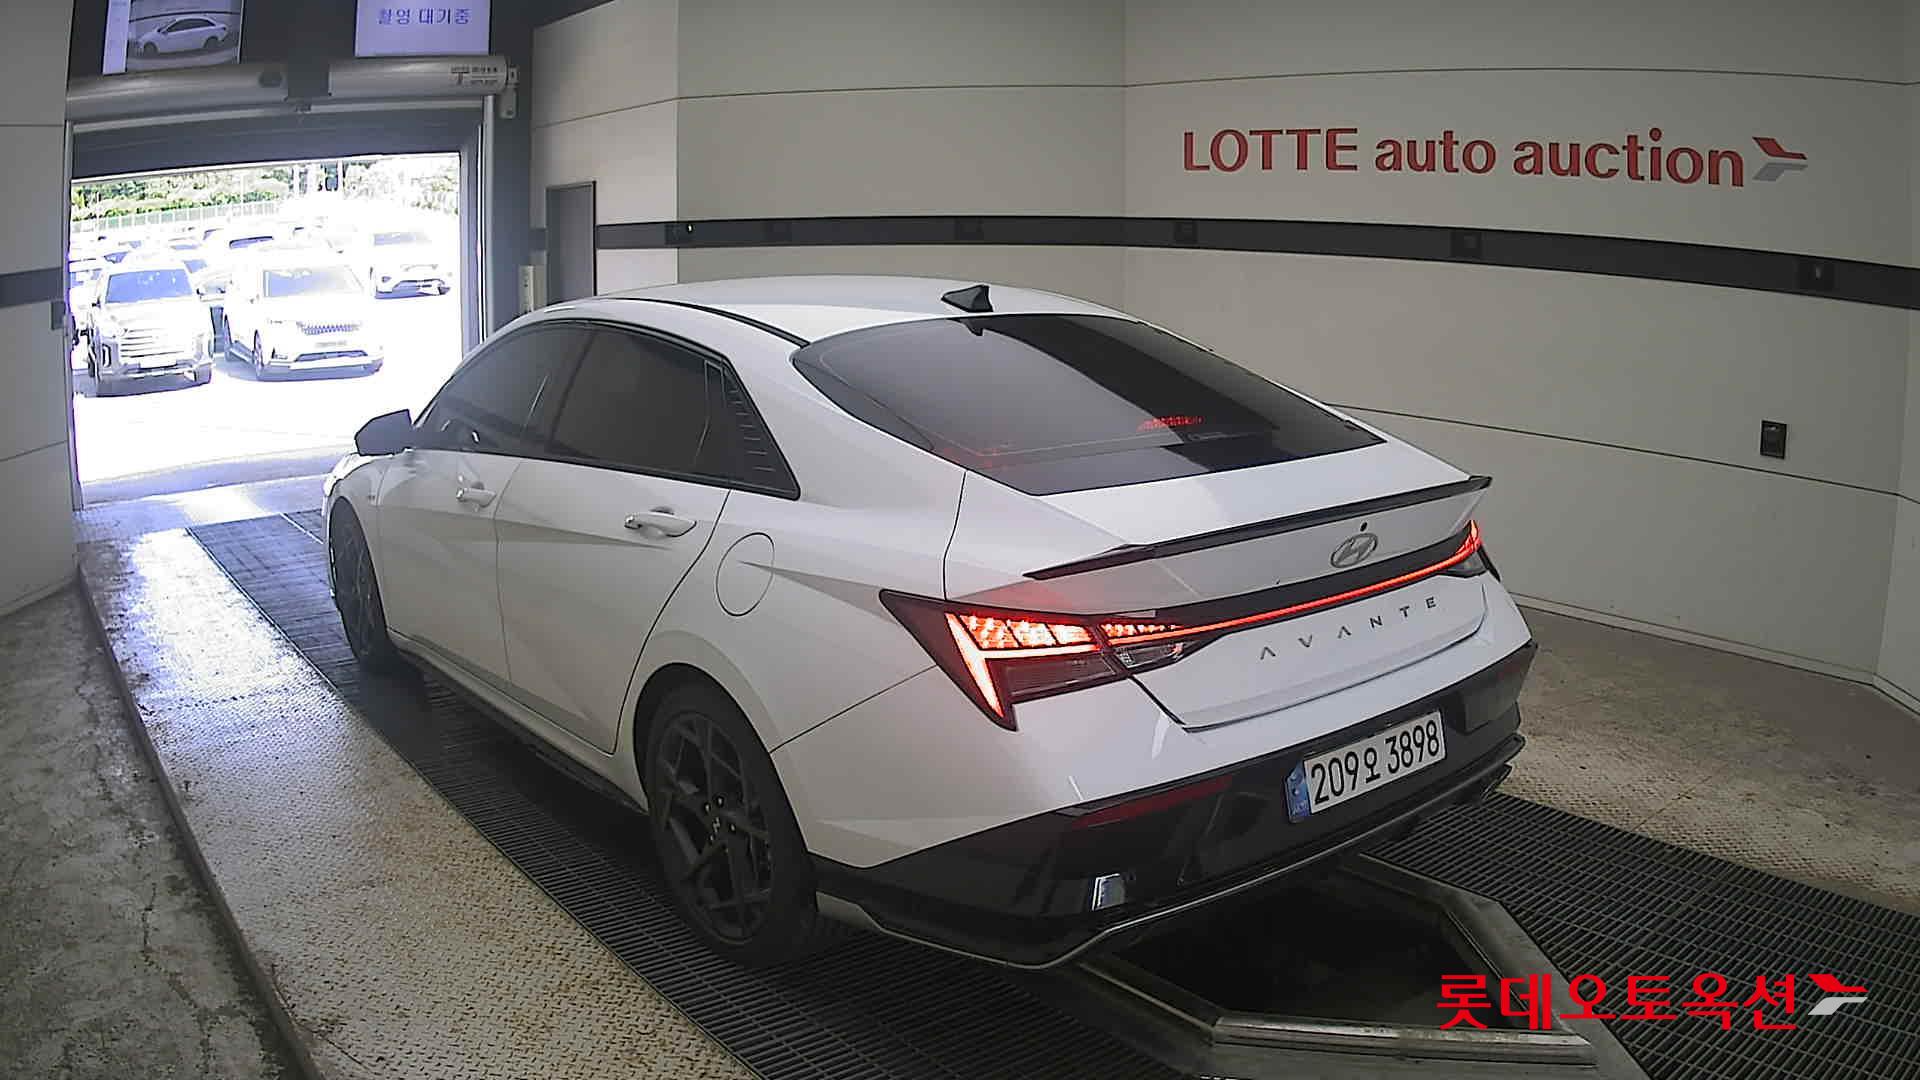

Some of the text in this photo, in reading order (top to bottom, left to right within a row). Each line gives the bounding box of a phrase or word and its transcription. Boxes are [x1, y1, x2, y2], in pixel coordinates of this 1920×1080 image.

[419, 8, 470, 25] 대기중
[1183, 127, 1744, 187] LOTTE auto auction
[1260, 597, 1437, 660] AVANTE
[1311, 720, 1440, 805] 209오 3898
